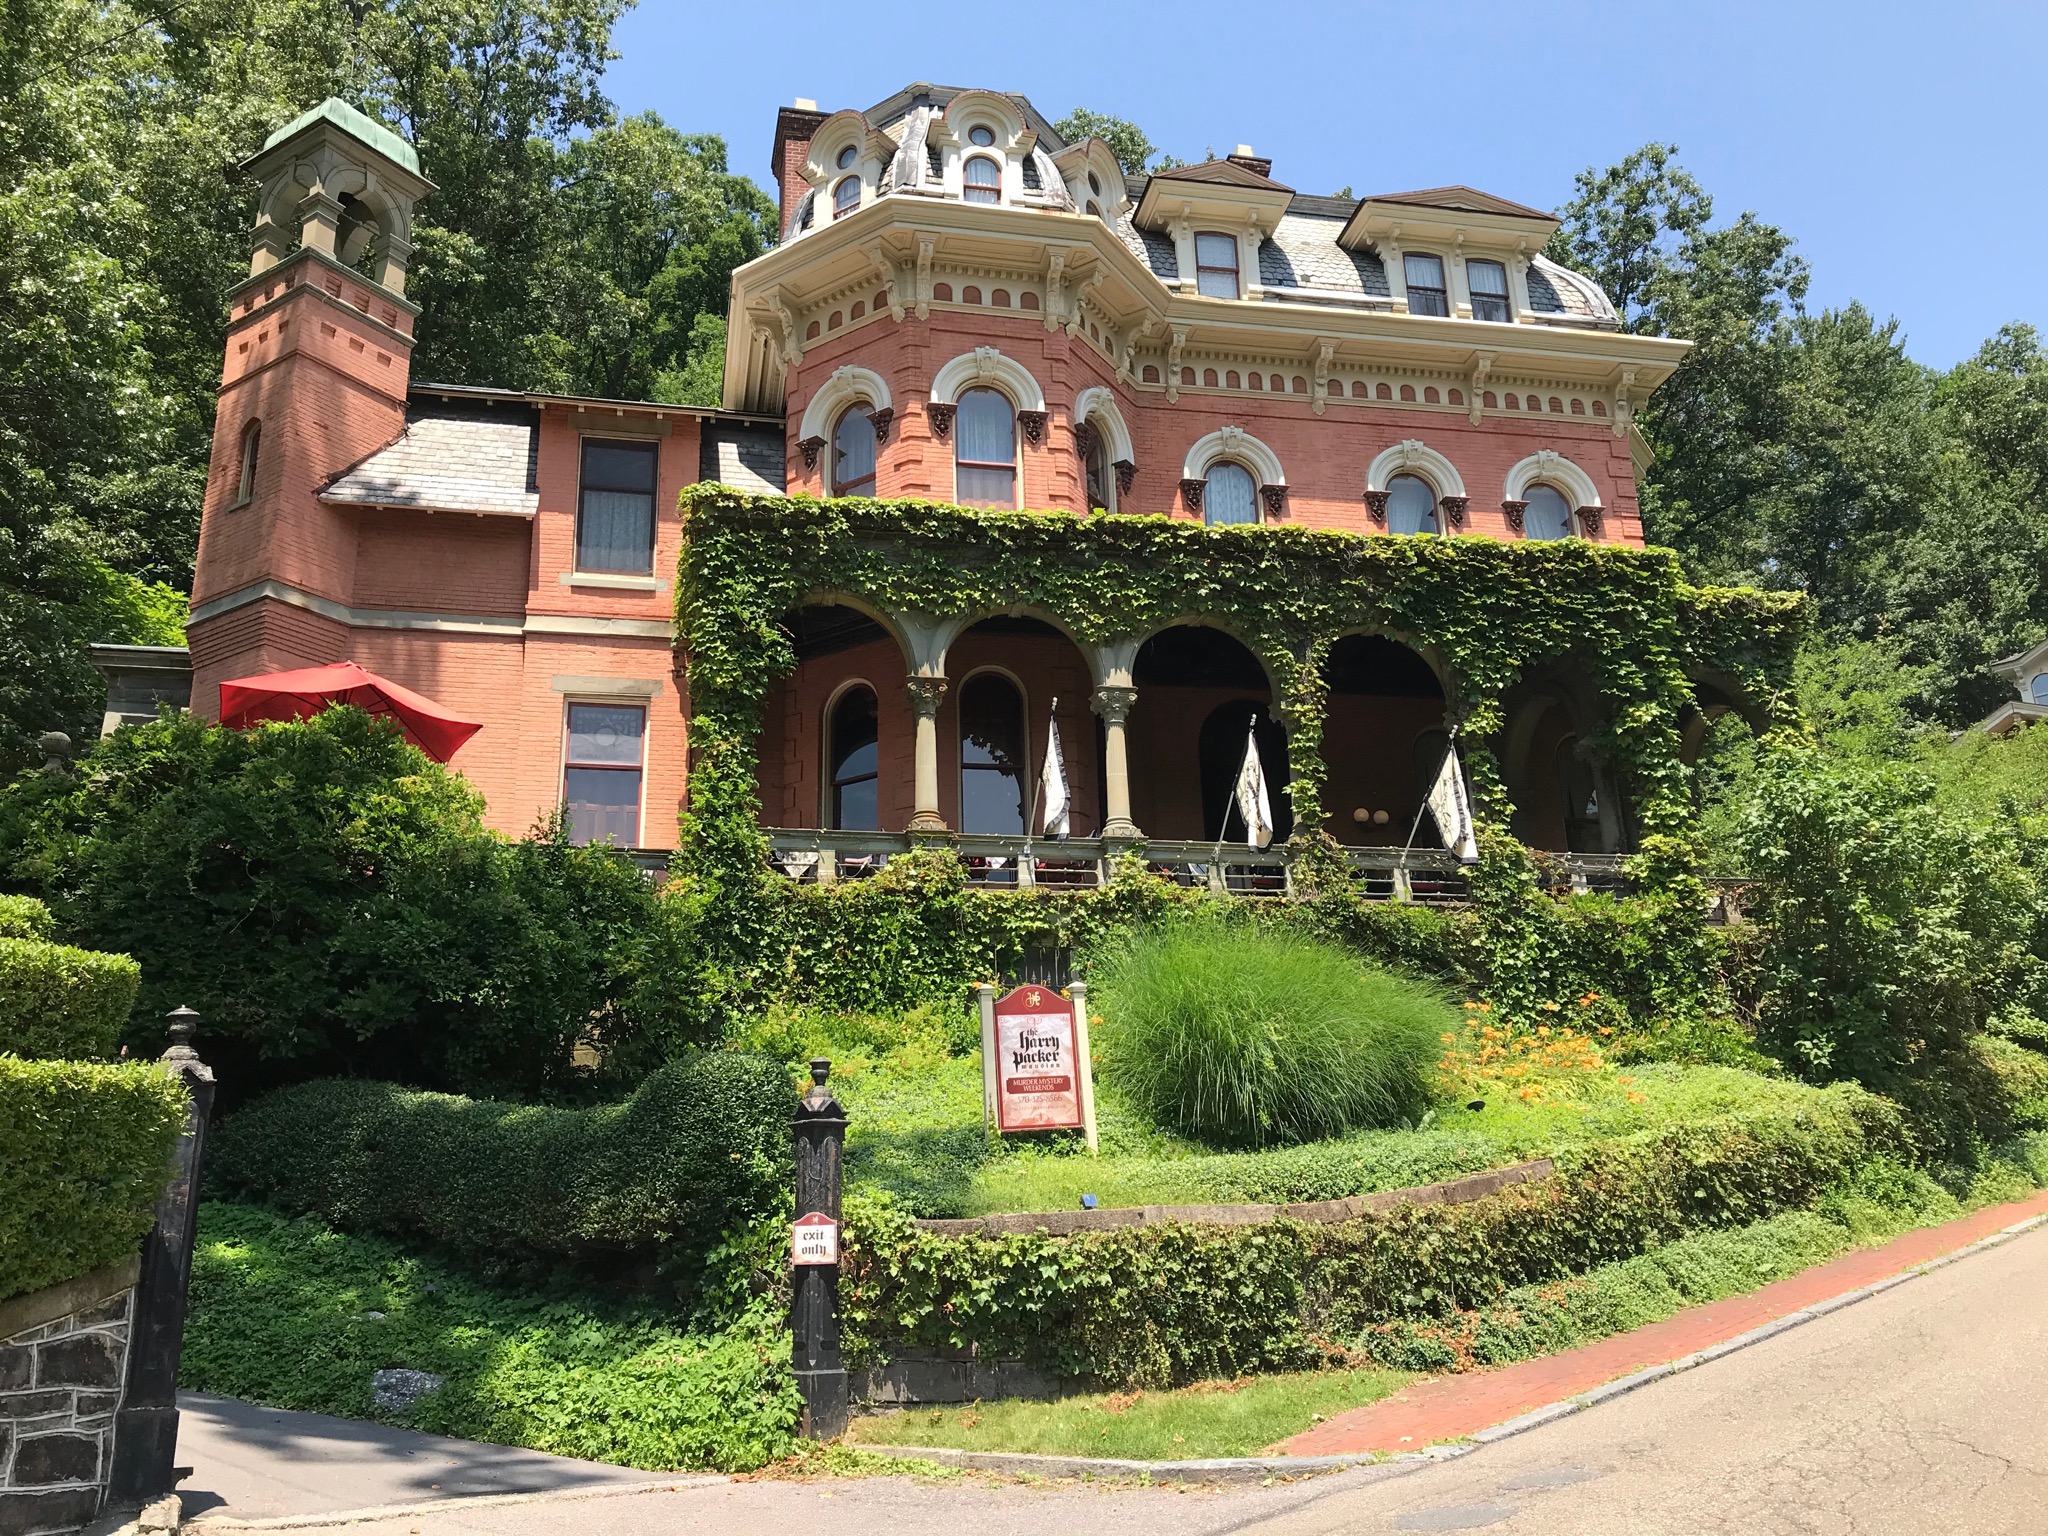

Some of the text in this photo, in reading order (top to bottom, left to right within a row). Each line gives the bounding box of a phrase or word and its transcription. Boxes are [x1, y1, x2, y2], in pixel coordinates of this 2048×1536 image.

[1027, 1028, 1038, 1037] the
[1038, 1077, 1064, 1085] MYSTERY
[1023, 1084, 1055, 1092] WEEKENDS
[803, 1229, 824, 1240] exit
[801, 1244, 826, 1256] only
